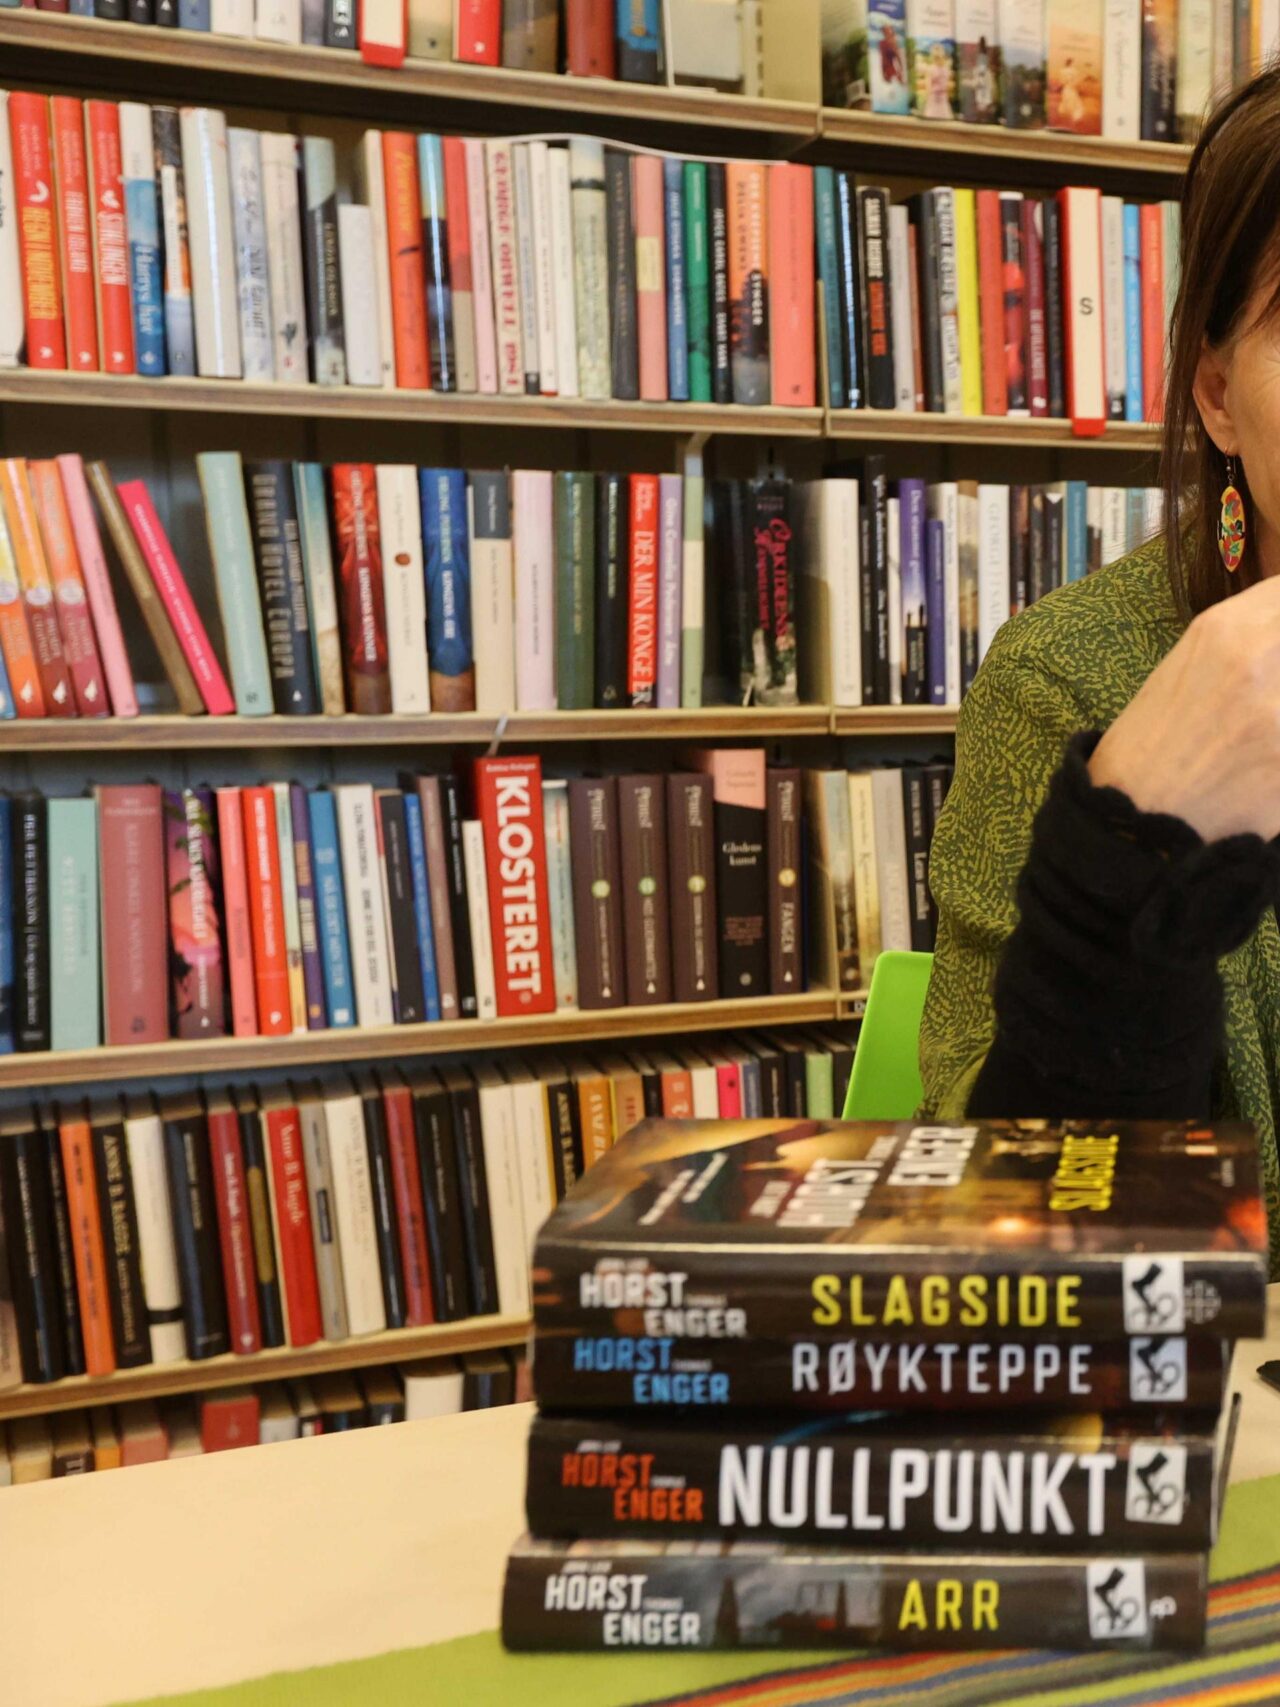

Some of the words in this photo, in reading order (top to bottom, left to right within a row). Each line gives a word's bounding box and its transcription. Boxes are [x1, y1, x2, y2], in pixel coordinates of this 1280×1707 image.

[1079, 296, 1094, 316] S
[633, 530, 655, 567] DER
[633, 571, 654, 607] MIN
[631, 611, 653, 678] KONGE
[631, 680, 651, 706] ER
[495, 775, 542, 994] KLOSTERET
[886, 1126, 979, 1187] ENGER
[1049, 1134, 1119, 1211] SLAGSIDE
[777, 1157, 884, 1228] HORST
[580, 1272, 689, 1309] HORST
[811, 1273, 1083, 1328] SLAGSIDE
[643, 1307, 748, 1338] ENGER
[573, 1337, 676, 1372] HORST
[792, 1338, 1093, 1395] RØYKTEPPE
[632, 1372, 730, 1404] ENGER
[561, 1453, 655, 1488] HORST
[612, 1486, 704, 1522] ENGER
[717, 1445, 1117, 1536] NULLPUNKT
[545, 1574, 649, 1611] HORST
[899, 1578, 1001, 1632] ARR
[602, 1611, 701, 1646] ENGER
